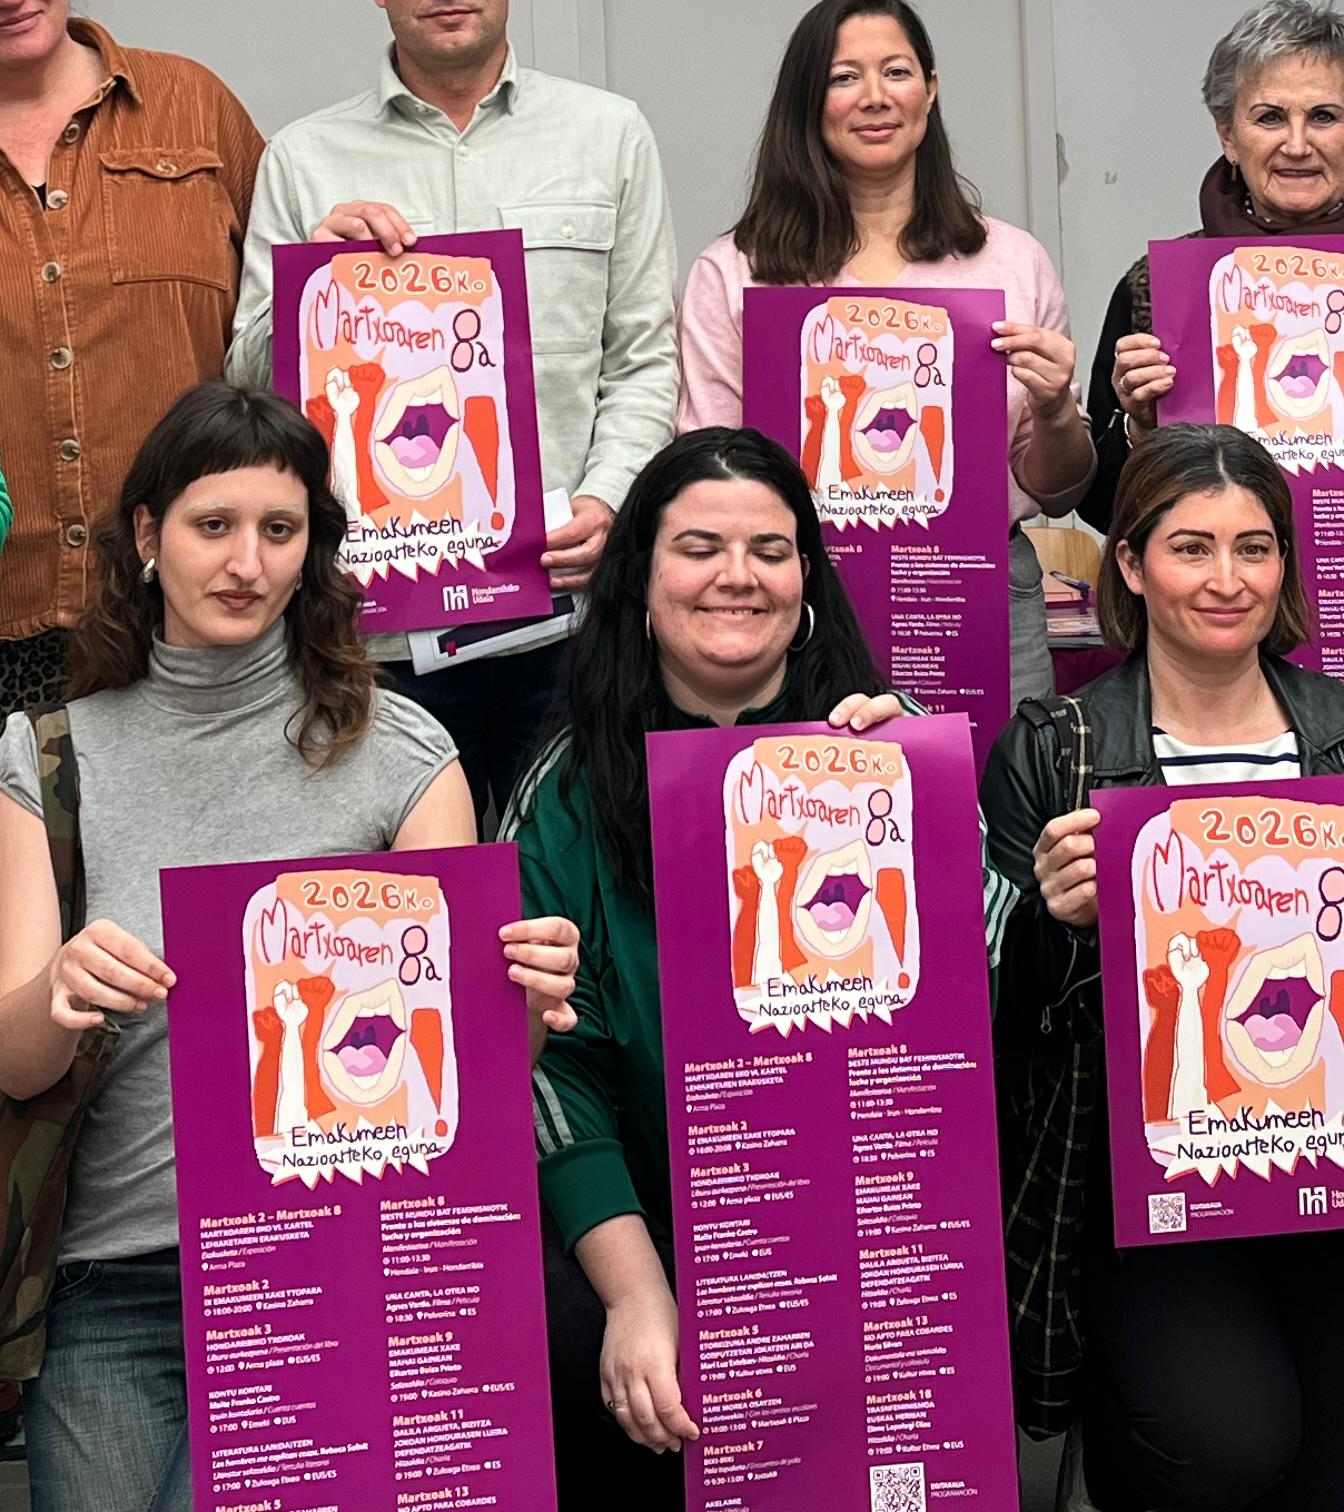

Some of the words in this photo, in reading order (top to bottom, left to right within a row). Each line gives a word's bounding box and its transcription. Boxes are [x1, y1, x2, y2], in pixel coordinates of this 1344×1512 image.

[1222, 264, 1321, 318] Martxoaren
[315, 279, 445, 352] Martxoaren
[813, 313, 911, 371] Martxoaren
[901, 503, 941, 517] eguna
[447, 534, 499, 559] eguna
[740, 760, 862, 828] Martxoaren
[1152, 828, 1310, 918] Martxoaren
[261, 897, 394, 967] Martxoaren
[858, 992, 905, 1011] eguna
[391, 1140, 443, 1162] eguna
[380, 1196, 436, 1211] Martxoak
[200, 1213, 256, 1229] Martxoak
[257, 1212, 266, 1223] 2
[276, 1206, 332, 1222] Martxoak
[333, 1204, 342, 1216] 8
[203, 1279, 262, 1296] Martxoak
[261, 1279, 270, 1290] 2
[206, 1324, 263, 1341] Martxoak
[264, 1323, 272, 1335] 3
[387, 1333, 443, 1348] Martxoak
[444, 1331, 453, 1341] 9
[702, 1389, 754, 1405] Martxoak
[754, 1388, 763, 1398] 6
[866, 1389, 917, 1405] Martxoak
[393, 1411, 449, 1427] Martxoak
[450, 1409, 465, 1420] 11
[704, 1441, 755, 1457] Martxoak
[756, 1440, 764, 1451] 7
[397, 1488, 453, 1505] Martxoak
[454, 1486, 470, 1497] 13
